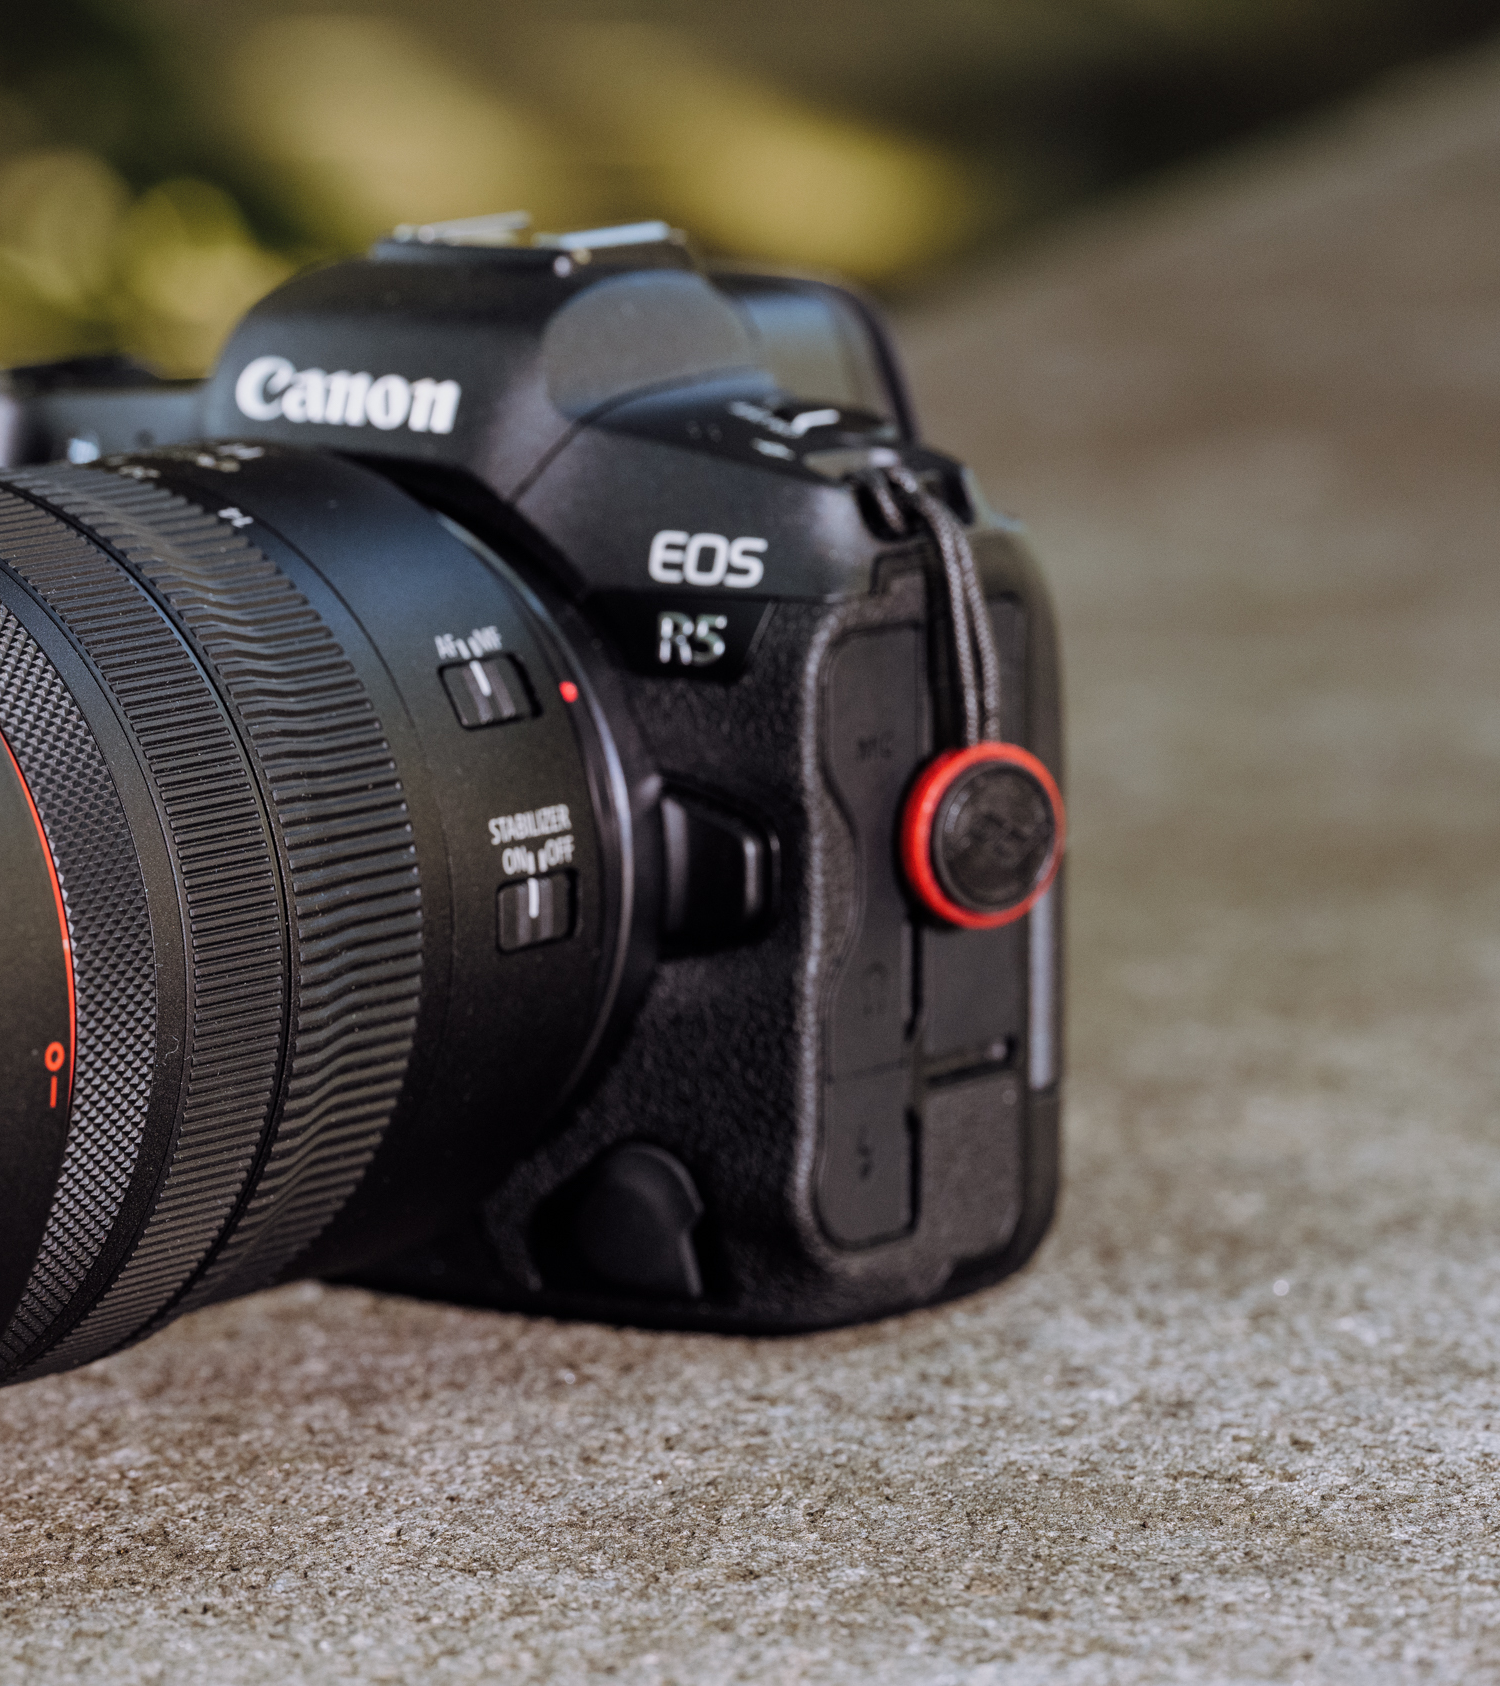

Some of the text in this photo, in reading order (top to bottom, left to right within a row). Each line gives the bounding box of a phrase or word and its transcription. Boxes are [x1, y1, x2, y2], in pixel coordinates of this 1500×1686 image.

[235, 356, 461, 434] Canon
[648, 530, 768, 588] EOS
[658, 611, 728, 666] R5
[488, 803, 572, 846] STABILIZER
[544, 834, 575, 867] OFF
